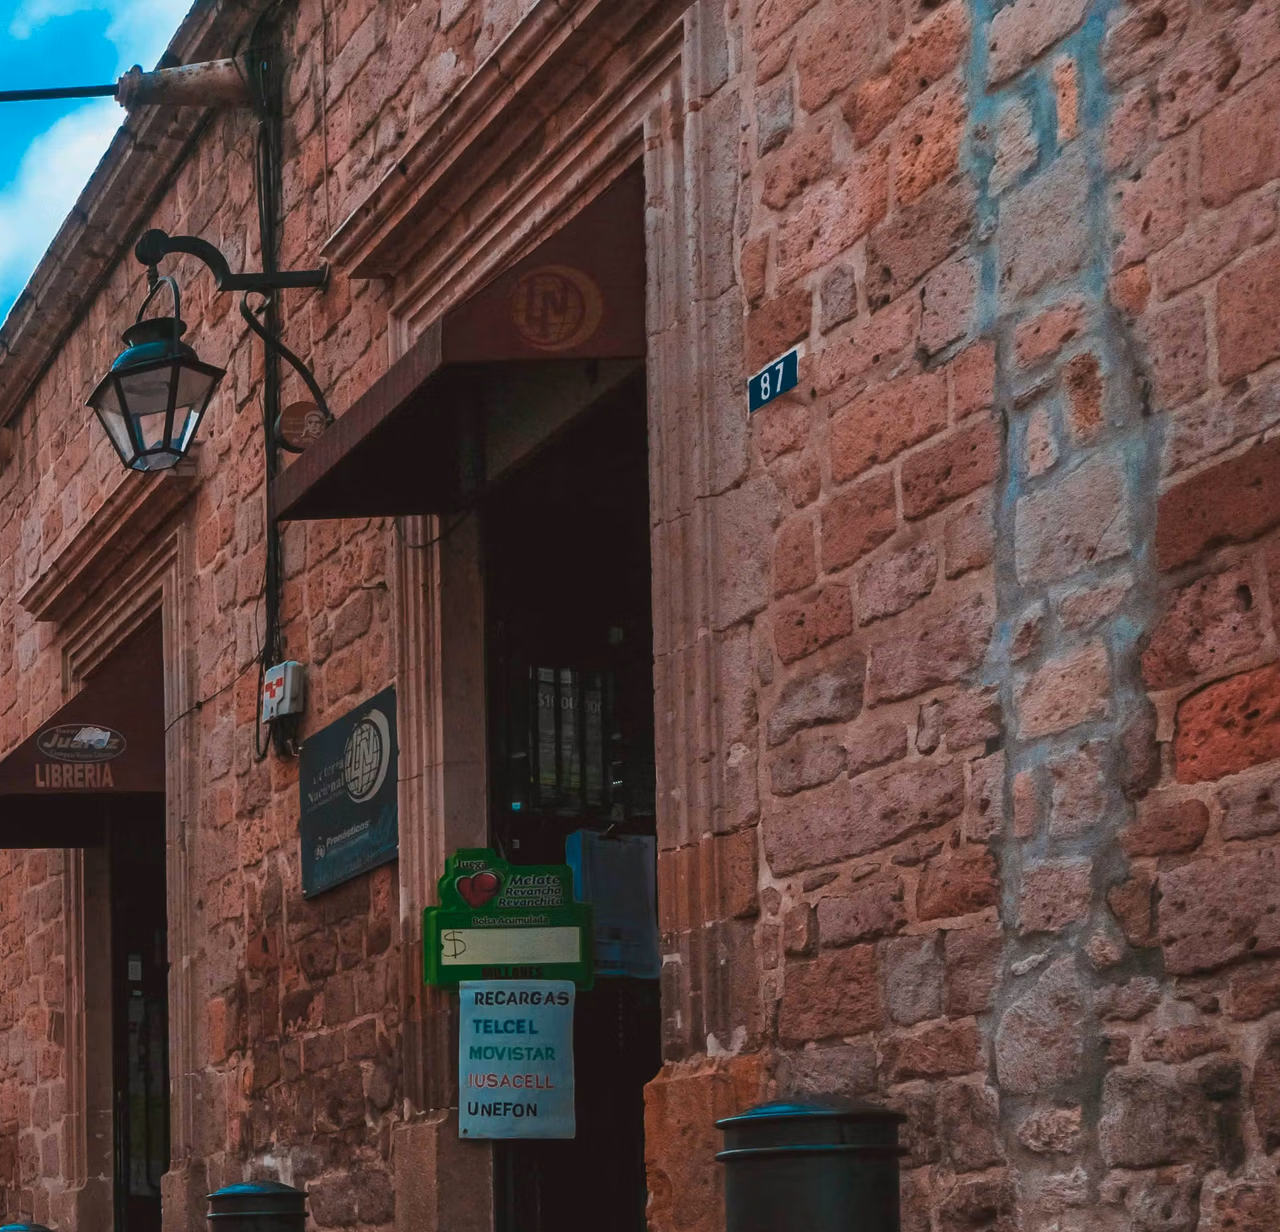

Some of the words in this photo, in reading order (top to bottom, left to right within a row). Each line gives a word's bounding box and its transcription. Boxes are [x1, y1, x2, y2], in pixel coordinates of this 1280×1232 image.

[760, 361, 784, 400] 87
[43, 734, 120, 749] Juarz
[35, 762, 115, 788] LIBRERIA
[455, 859, 487, 870] Juega
[509, 874, 561, 886] Melate
[505, 886, 561, 897] Revancha
[497, 897, 564, 908] Revanchita
[472, 916, 496, 926] Bolsa
[498, 915, 550, 925] Acumulada
[443, 930, 467, 959] $
[474, 990, 570, 1006] RECARGAS
[473, 1019, 539, 1035] TELCEL
[469, 1046, 556, 1061] MOVISTAR
[468, 1073, 555, 1089] IUSACELL
[467, 1101, 538, 1118] UNEFON
